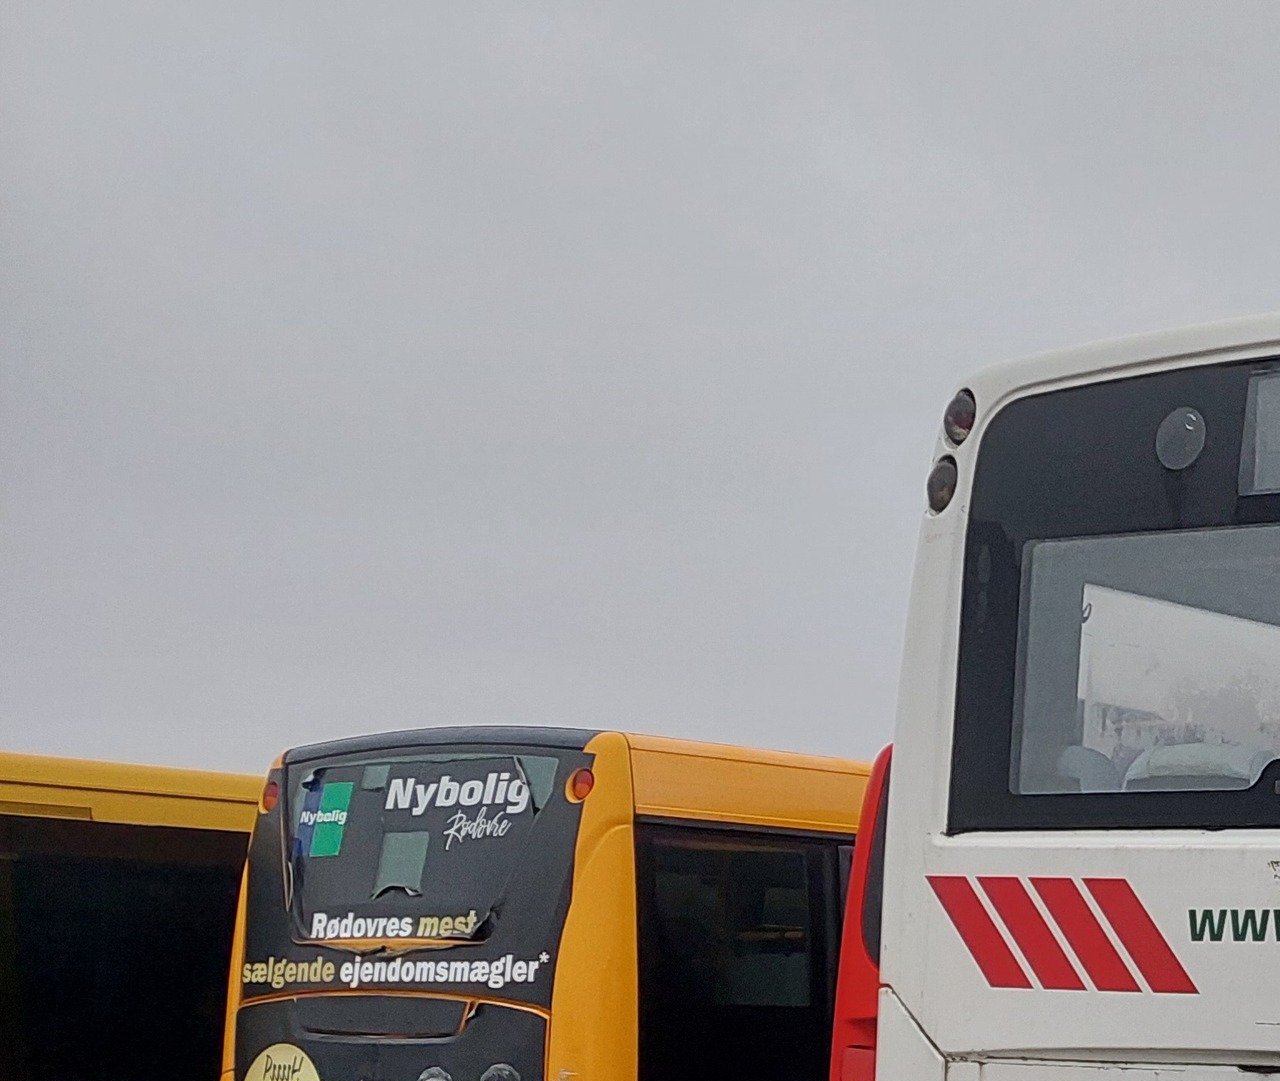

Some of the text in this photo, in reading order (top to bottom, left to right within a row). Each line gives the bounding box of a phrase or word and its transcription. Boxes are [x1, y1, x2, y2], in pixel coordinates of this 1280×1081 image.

[384, 772, 531, 816] Nybolig
[300, 809, 348, 826] Nybolig
[310, 909, 478, 940] Rødovres mest
[242, 956, 336, 988] sælgende
